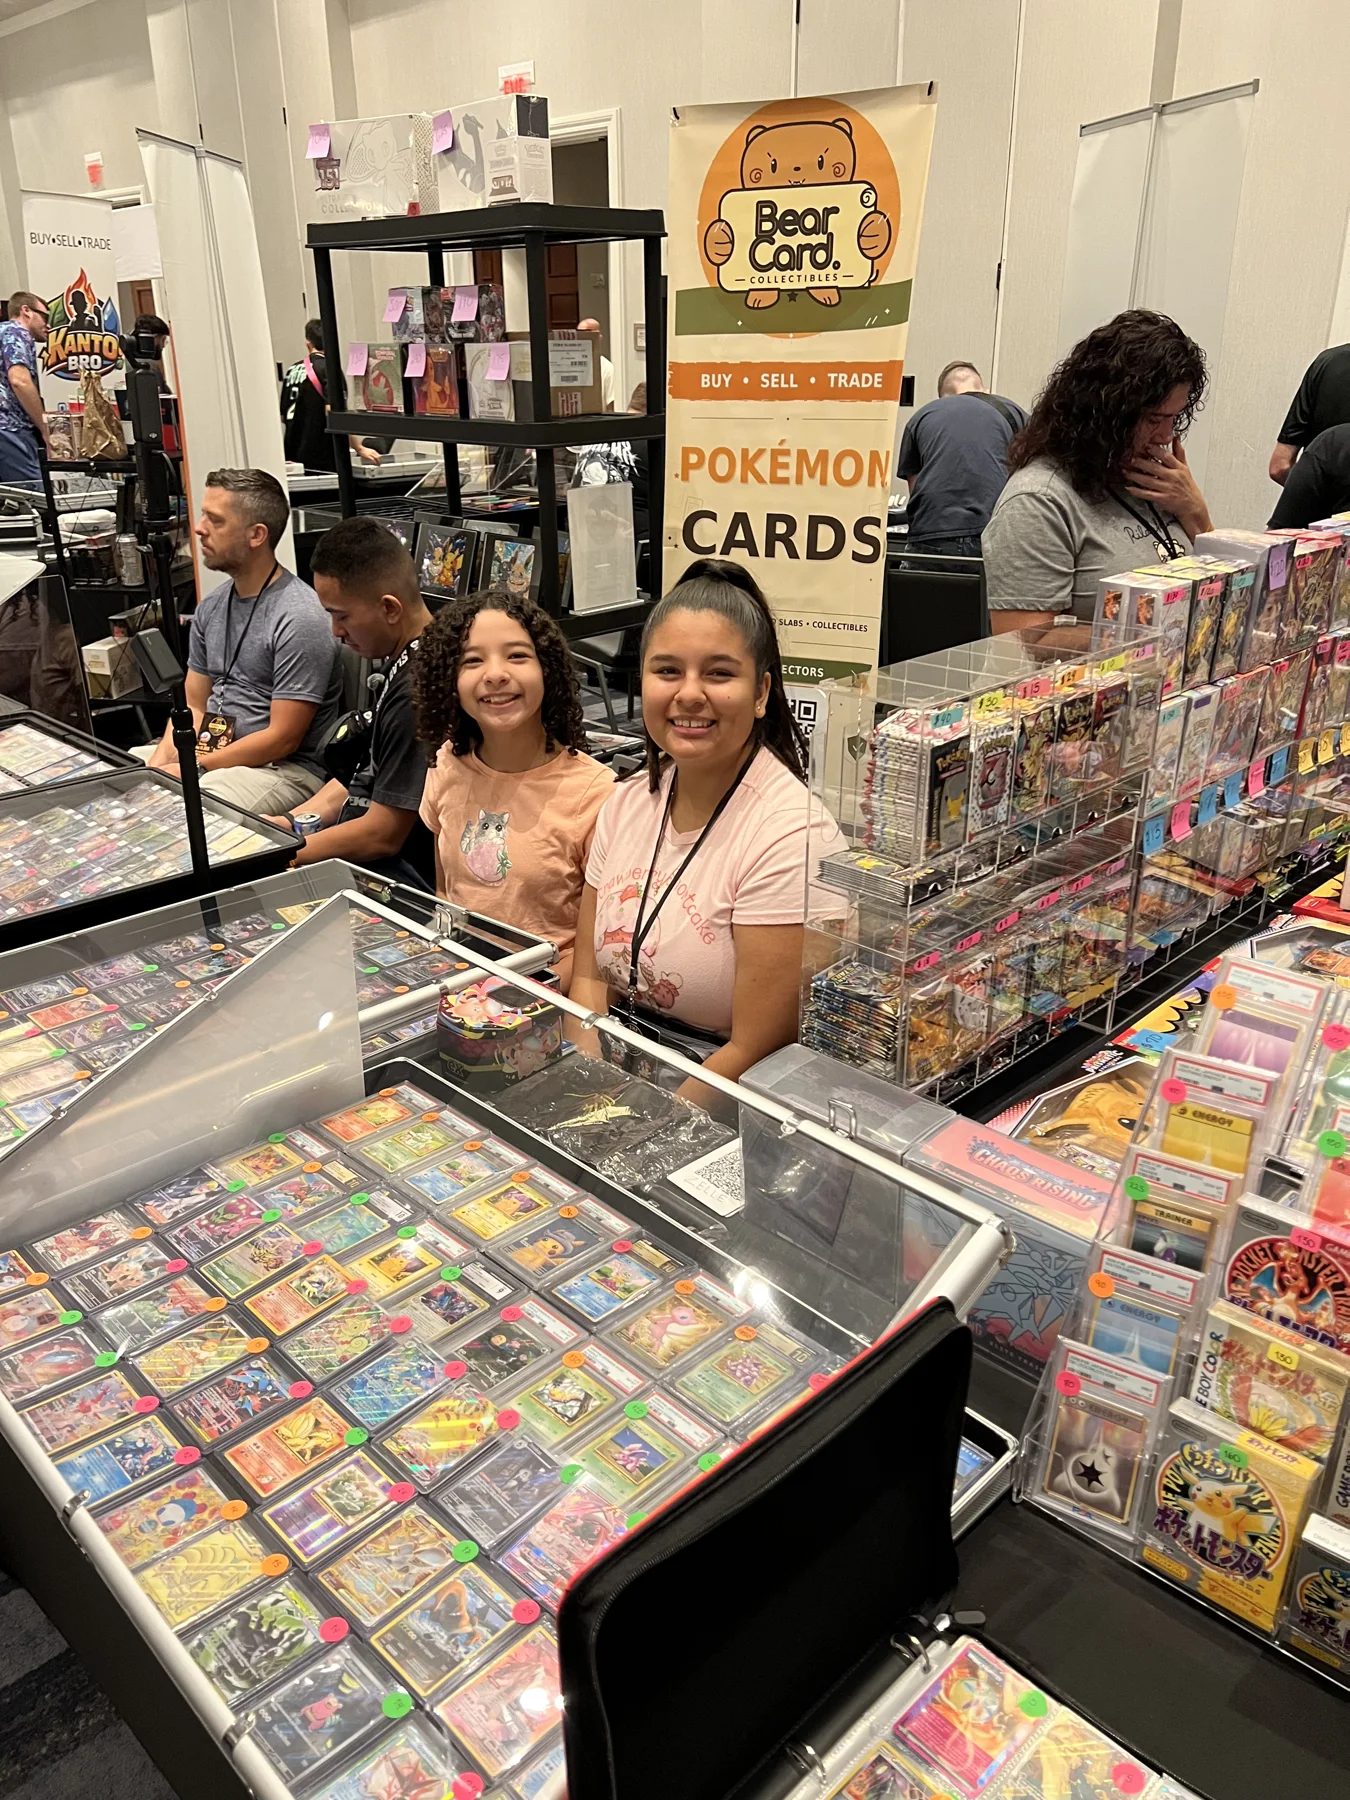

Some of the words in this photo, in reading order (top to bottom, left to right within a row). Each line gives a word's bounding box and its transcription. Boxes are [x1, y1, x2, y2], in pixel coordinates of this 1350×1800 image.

[755, 200, 840, 238] Bear
[749, 232, 841, 272] Card.
[750, 273, 839, 285] COLLECTIBLES
[48, 327, 120, 368] KANTO
[68, 354, 102, 371] BRO
[700, 373, 733, 388] BUY
[760, 373, 798, 388] SELL
[828, 372, 883, 388] TRADE
[680, 439, 891, 488] POKÉMON
[682, 509, 882, 564] CARDS
[779, 619, 804, 628] SLABS
[812, 621, 869, 634] COLLECTIBLES
[782, 664, 825, 679] ECTORS
[933, 712, 952, 727] $40
[1192, 1110, 1235, 1127] ENERGY
[974, 1148, 1029, 1181] CHAOS
[1031, 1177, 1098, 1208] RISING
[684, 1177, 728, 1203] ZELLE
[1155, 1208, 1193, 1227] TRAINER
[1121, 1305, 1162, 1324] ENERGY
[792, 1348, 808, 1363] 10
[1202, 1331, 1225, 1374] COLOR
[1200, 1372, 1213, 1399] BOY
[1153, 1505, 1273, 1581] ポケットモンスター
